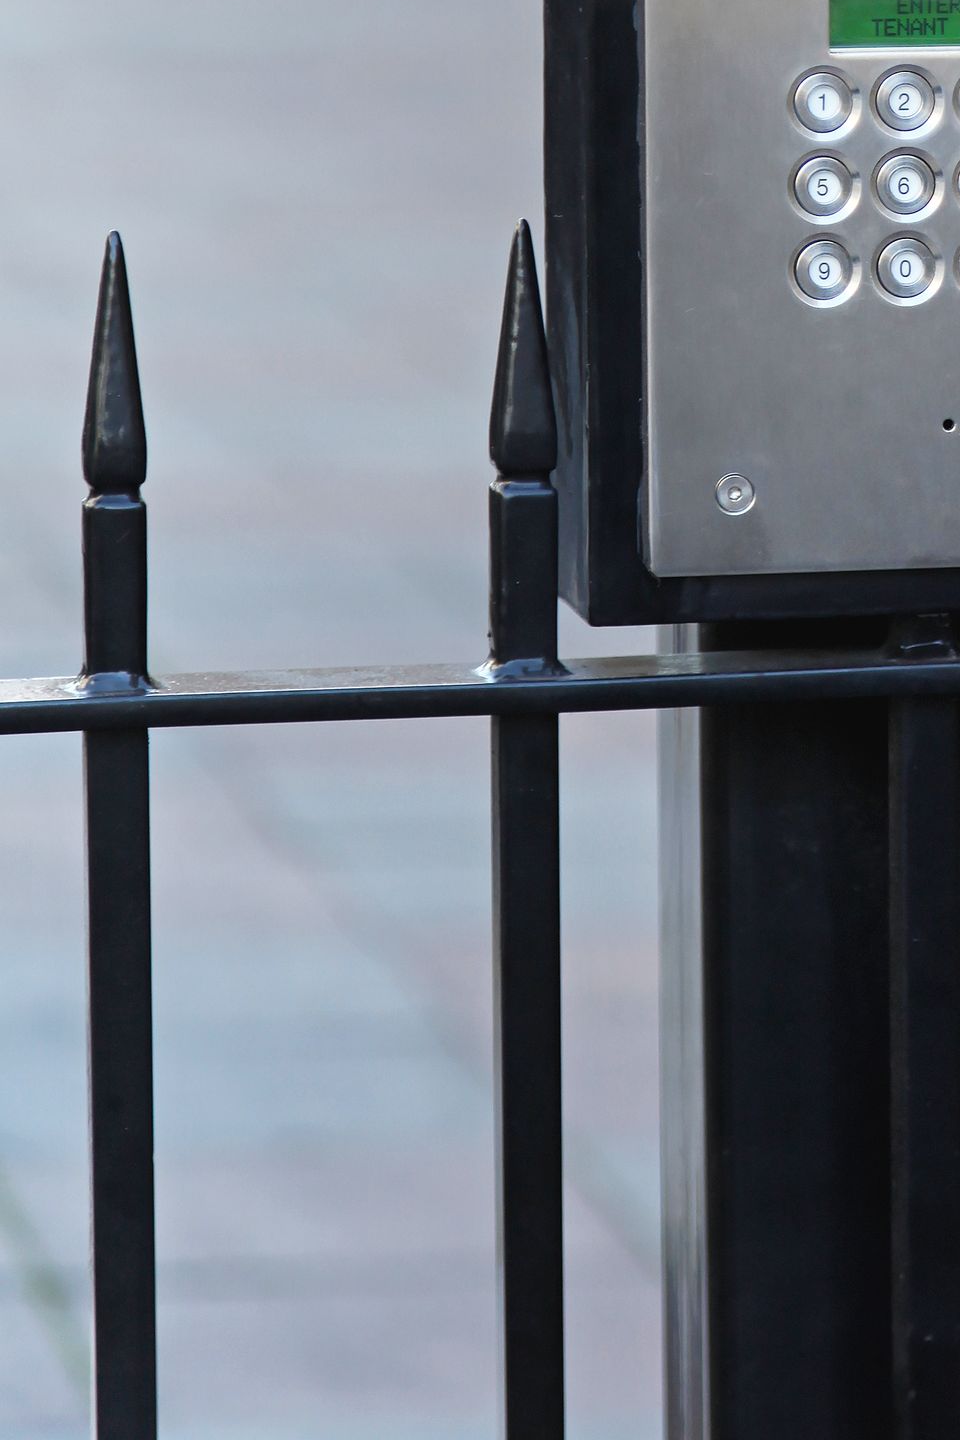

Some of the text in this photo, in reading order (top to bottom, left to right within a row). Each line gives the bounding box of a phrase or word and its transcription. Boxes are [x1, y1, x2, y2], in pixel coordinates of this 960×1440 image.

[871, 17, 946, 37] TENANT
[818, 93, 827, 111] 1
[898, 93, 910, 111] 2
[816, 178, 828, 196] 5
[897, 177, 909, 195] 6
[818, 262, 830, 280] 9
[899, 260, 911, 278] 0
